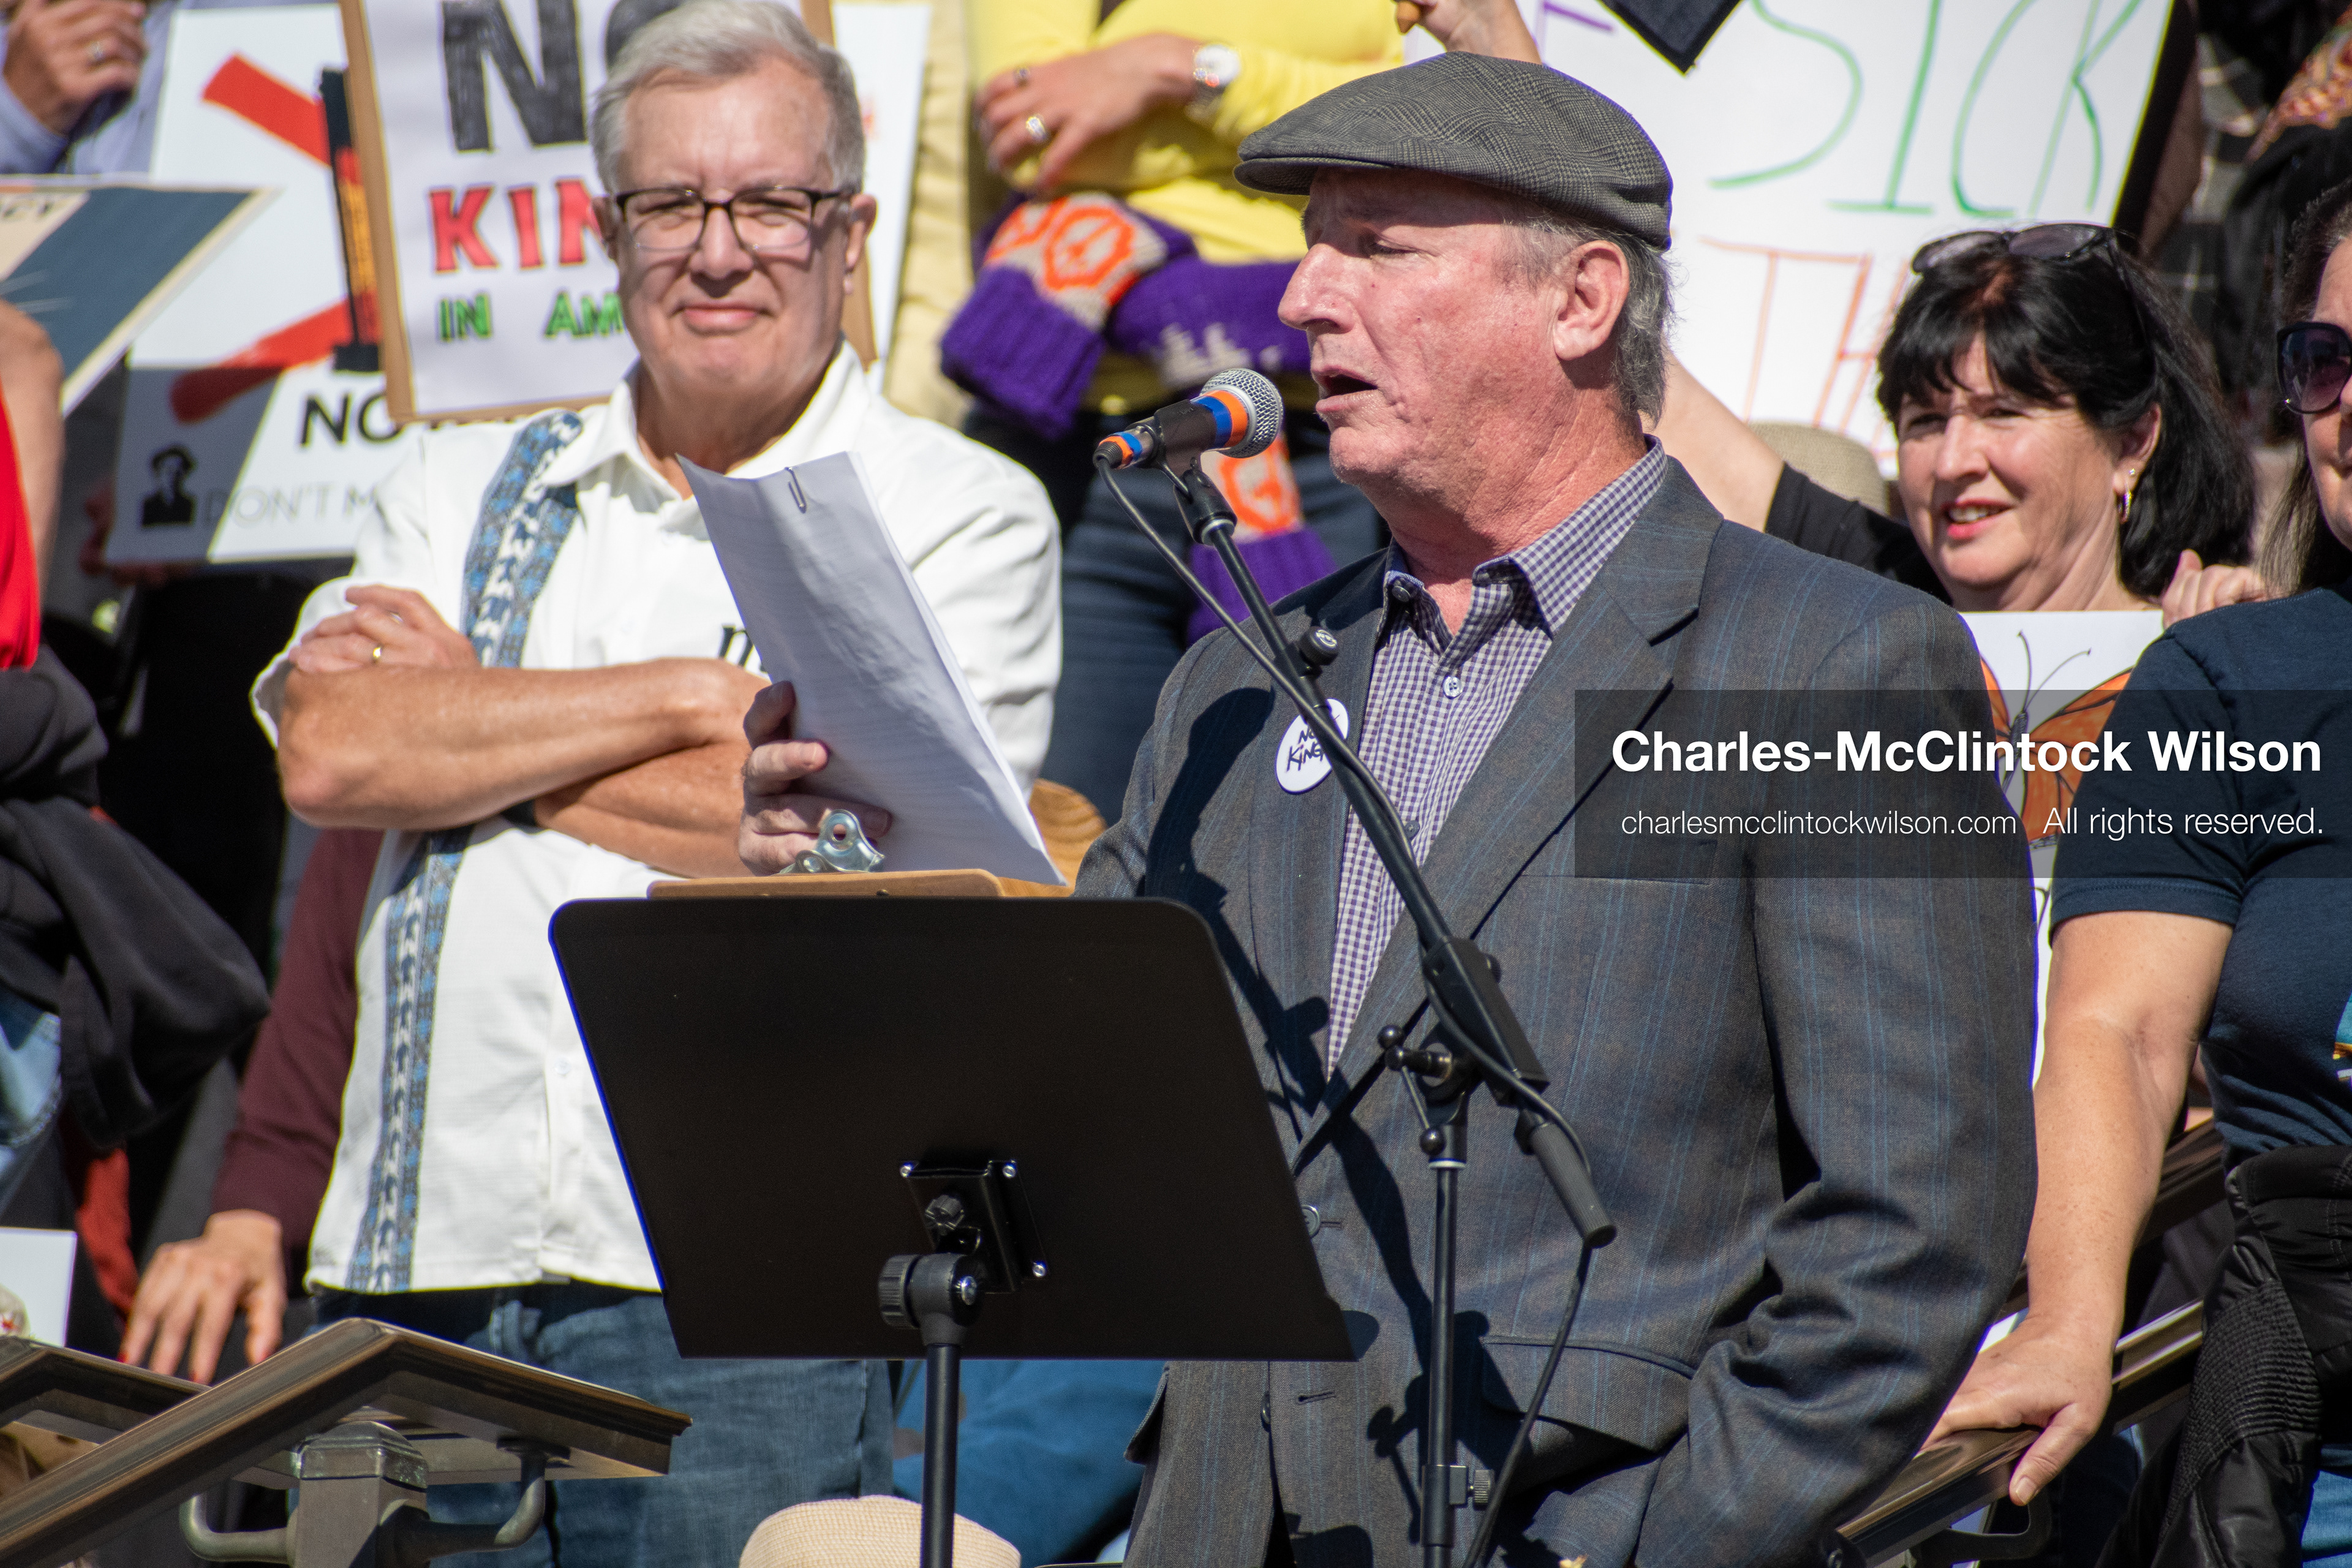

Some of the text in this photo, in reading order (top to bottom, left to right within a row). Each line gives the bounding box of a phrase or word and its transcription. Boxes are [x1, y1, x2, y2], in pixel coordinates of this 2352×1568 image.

[429, 179, 603, 273] KIN
[439, 291, 624, 342] IN AM
[1697, 234, 1909, 458] TH
